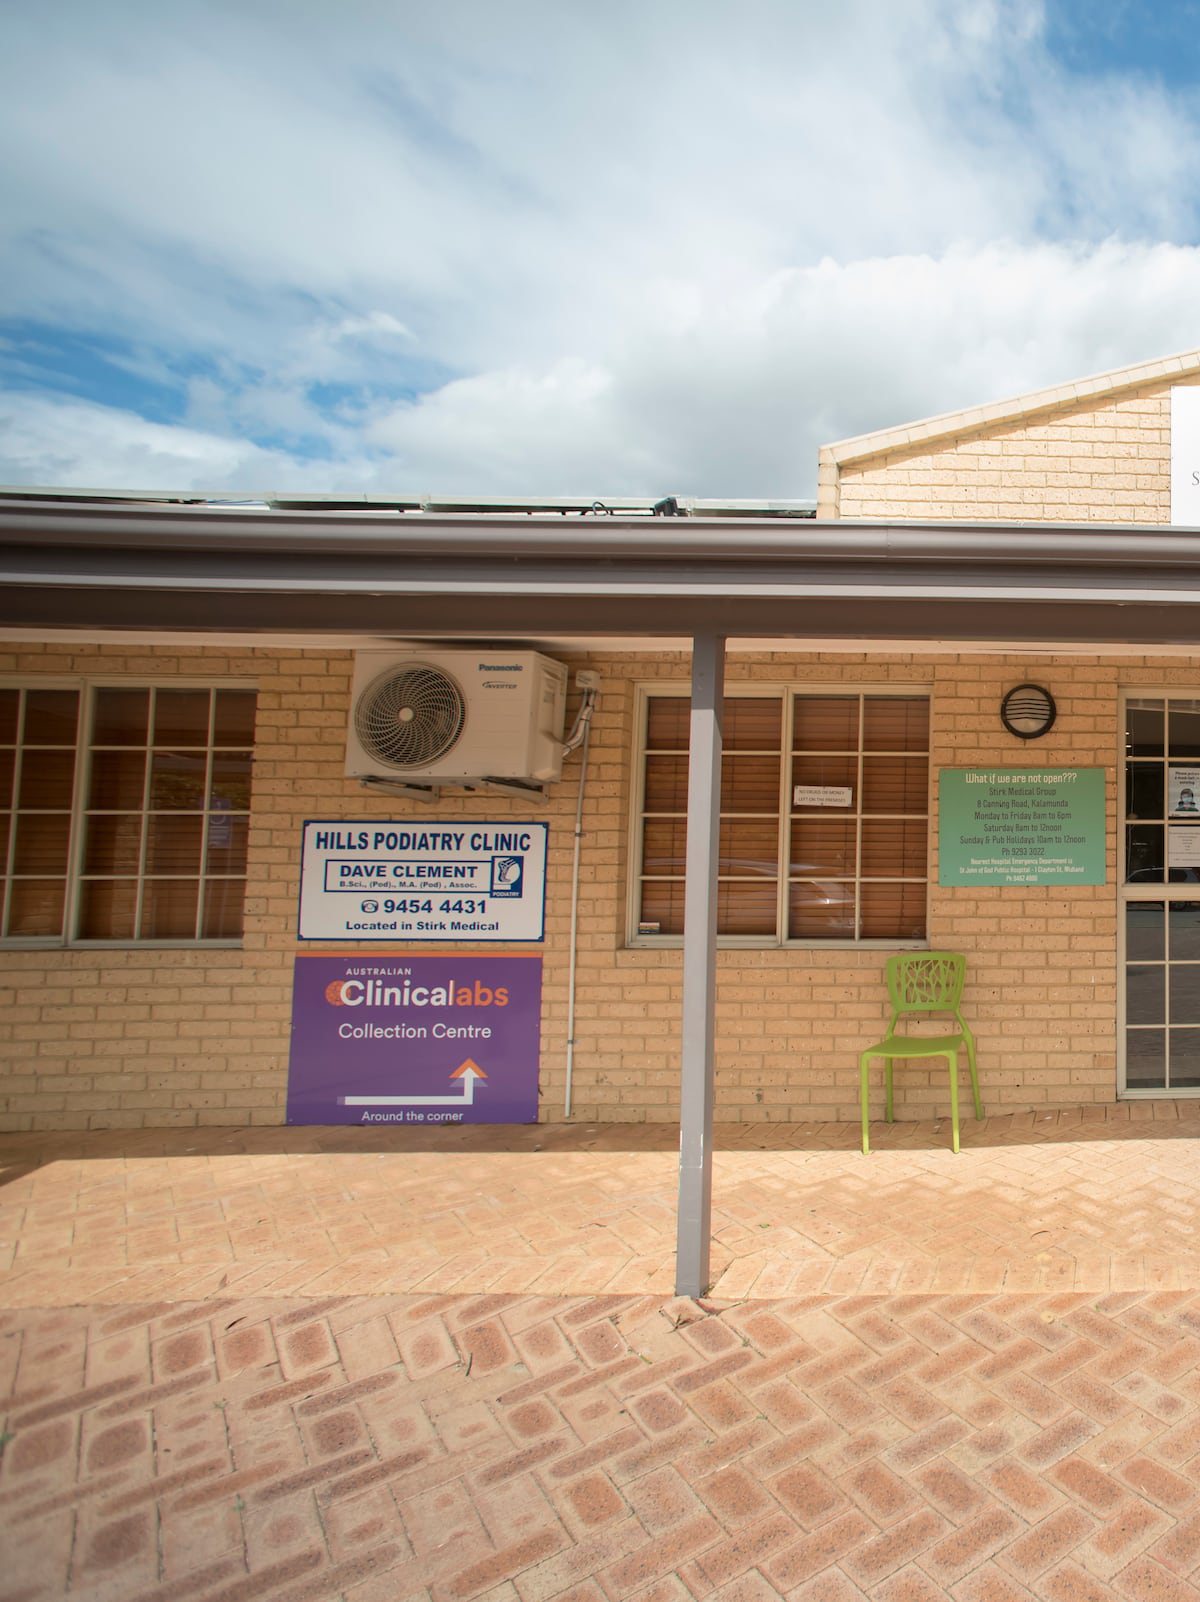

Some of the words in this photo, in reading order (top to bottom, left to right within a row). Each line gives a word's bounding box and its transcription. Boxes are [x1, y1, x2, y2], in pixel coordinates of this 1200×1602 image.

[965, 773, 988, 783] What
[989, 773, 996, 785] if
[997, 775, 1011, 783] we
[1012, 775, 1027, 783] are
[1028, 774, 1042, 783] not
[1043, 773, 1078, 784] open???
[989, 787, 1007, 796] Stirk
[1008, 787, 1035, 796] Medical
[1036, 787, 1057, 797] Group
[983, 800, 1010, 809] Canning
[1011, 800, 1030, 809] Road,
[1031, 800, 1069, 808] Kalamunda
[974, 812, 1000, 821] Monday
[1001, 812, 1009, 820] to
[1010, 812, 1032, 821] Friday
[1048, 812, 1056, 820] to
[983, 823, 1014, 832] Saturday
[1031, 824, 1038, 832] to
[1039, 823, 1062, 832] 12noon
[315, 831, 369, 850] HILLS
[373, 832, 465, 851] PODIATRY
[470, 833, 531, 851] CLINIC
[960, 835, 984, 844] Sunday
[985, 835, 990, 843] &
[992, 835, 1005, 844] Pub
[1006, 835, 1035, 845] Holidays
[1036, 835, 1054, 843] 10am
[1055, 835, 1062, 843] to
[1063, 835, 1086, 843] 12noon
[1001, 847, 1011, 855] Ph
[1011, 847, 1028, 855] 9293
[1028, 847, 1045, 856] 3022
[339, 865, 387, 878] DAVE
[392, 866, 478, 879] CLEMENT
[383, 900, 433, 914] 9454
[439, 900, 487, 914] 4431
[345, 921, 397, 931] Located
[401, 921, 413, 931] in
[416, 921, 447, 931] Stirk
[450, 921, 499, 931] Medical
[346, 967, 412, 976] AUSTRALIAN
[339, 979, 510, 1007] Clinicalabs
[338, 1023, 427, 1039] Collection
[432, 1023, 492, 1039] Centre
[361, 1111, 404, 1121] Around
[406, 1111, 424, 1121] the
[427, 1112, 464, 1121] corner
